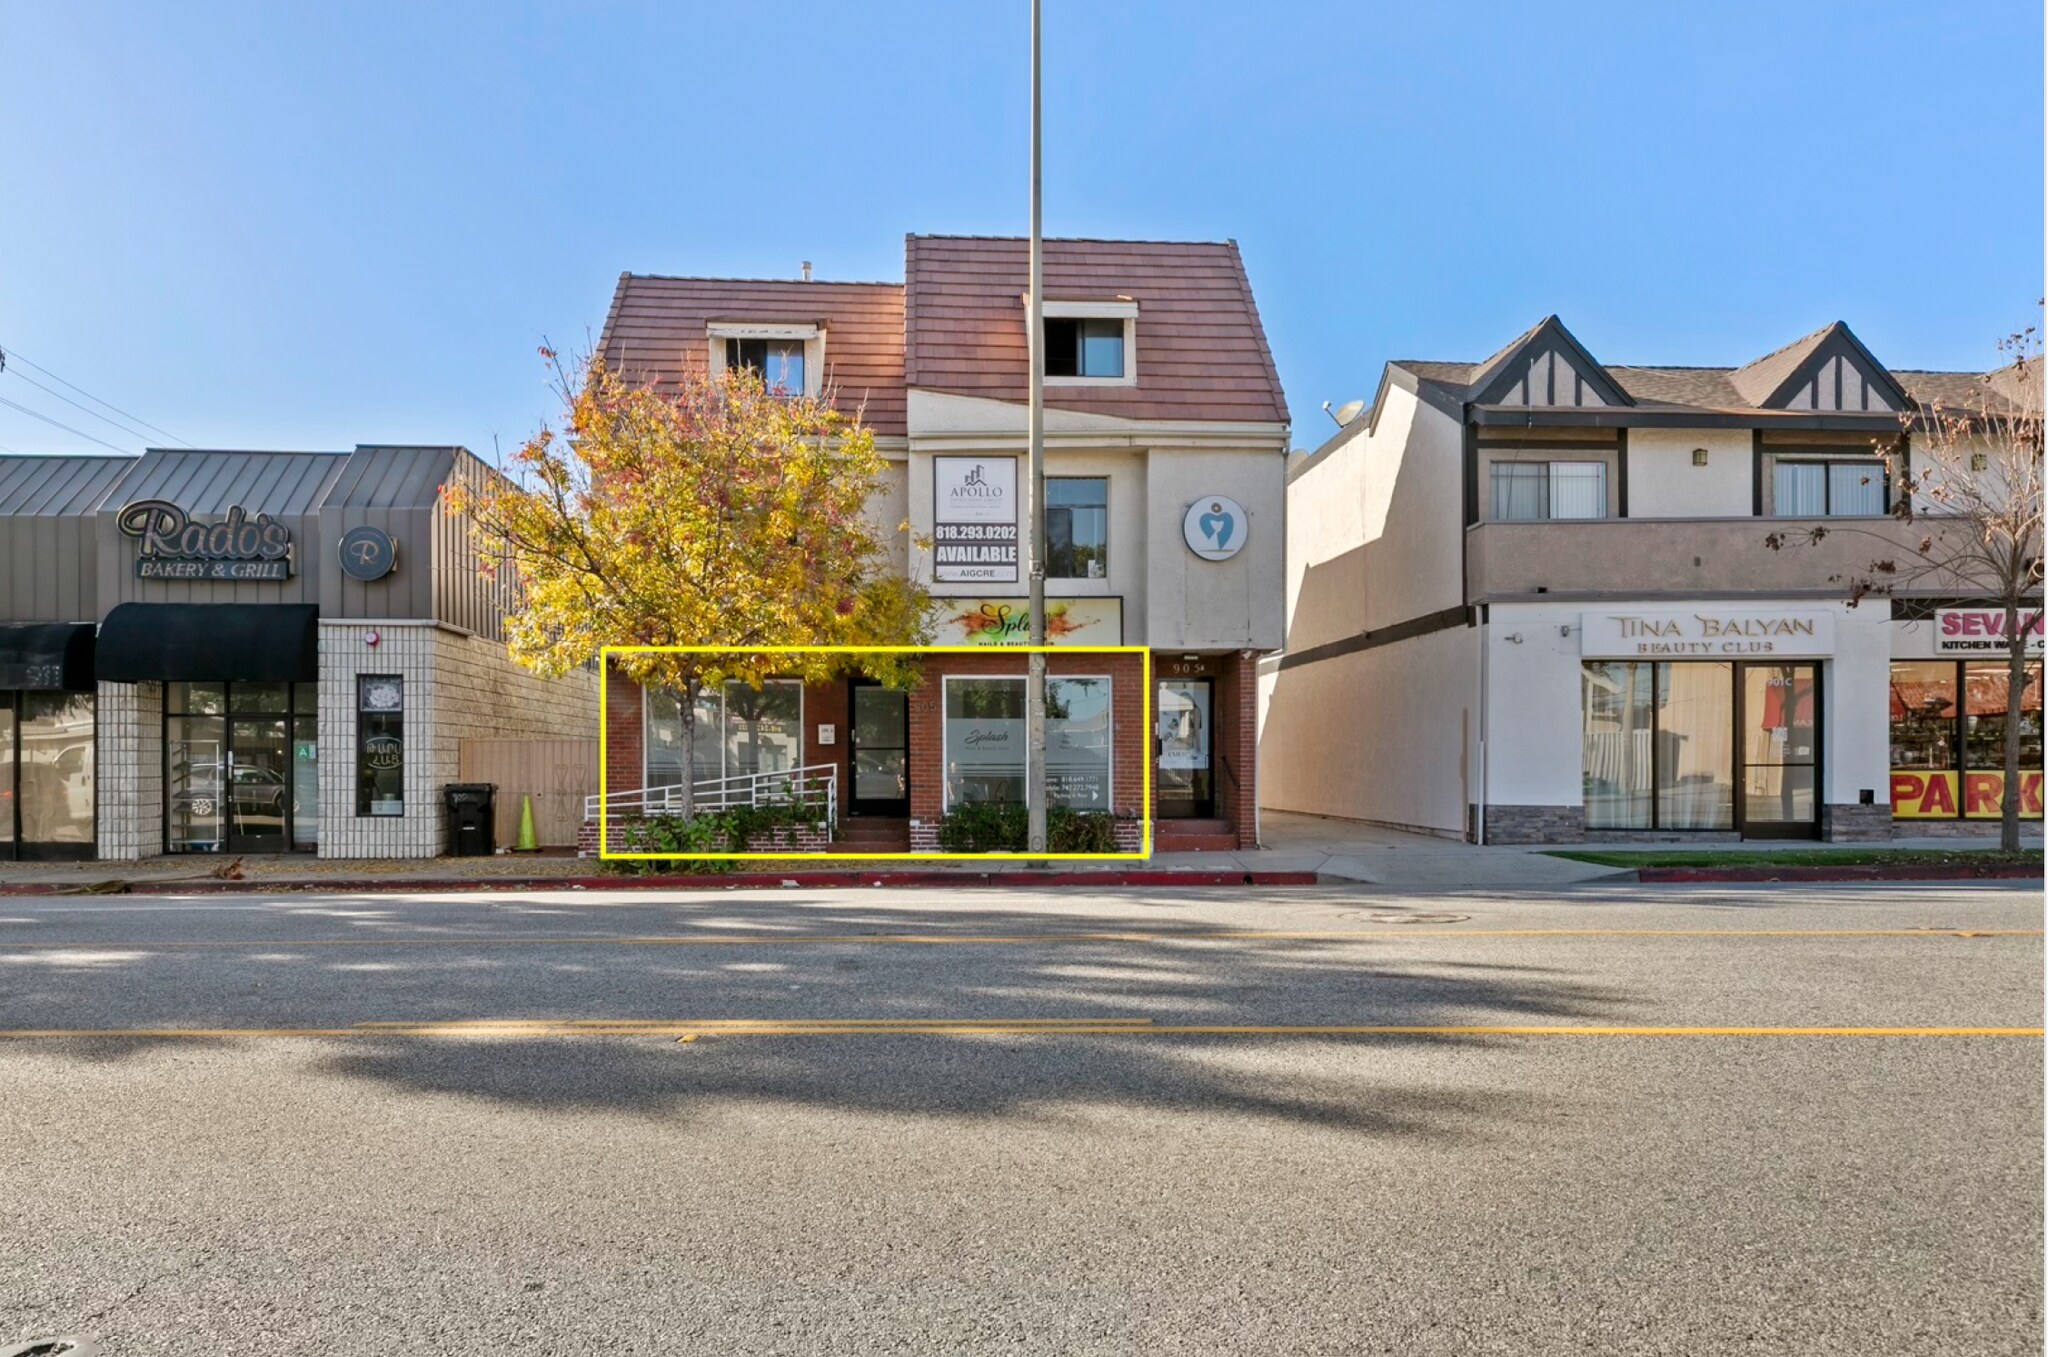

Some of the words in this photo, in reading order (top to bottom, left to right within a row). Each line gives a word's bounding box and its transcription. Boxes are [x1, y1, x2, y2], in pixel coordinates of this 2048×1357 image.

[950, 487, 1003, 497] APOLLO
[118, 501, 286, 558] Rado's
[936, 526, 1016, 539] 818.293.0202
[937, 546, 1016, 562] AVAILABLE
[141, 564, 208, 577] BAKERY
[212, 564, 226, 577] &
[231, 563, 281, 577] GRILL
[980, 604, 1042, 637] Spla
[1606, 616, 1683, 638] TINA
[1694, 614, 1814, 636] BALYAN
[1638, 642, 1712, 653] BEAUTY
[1942, 641, 1991, 649] KITCHEN
[1767, 678, 1793, 687] 901C
[964, 729, 1009, 746] Splash
